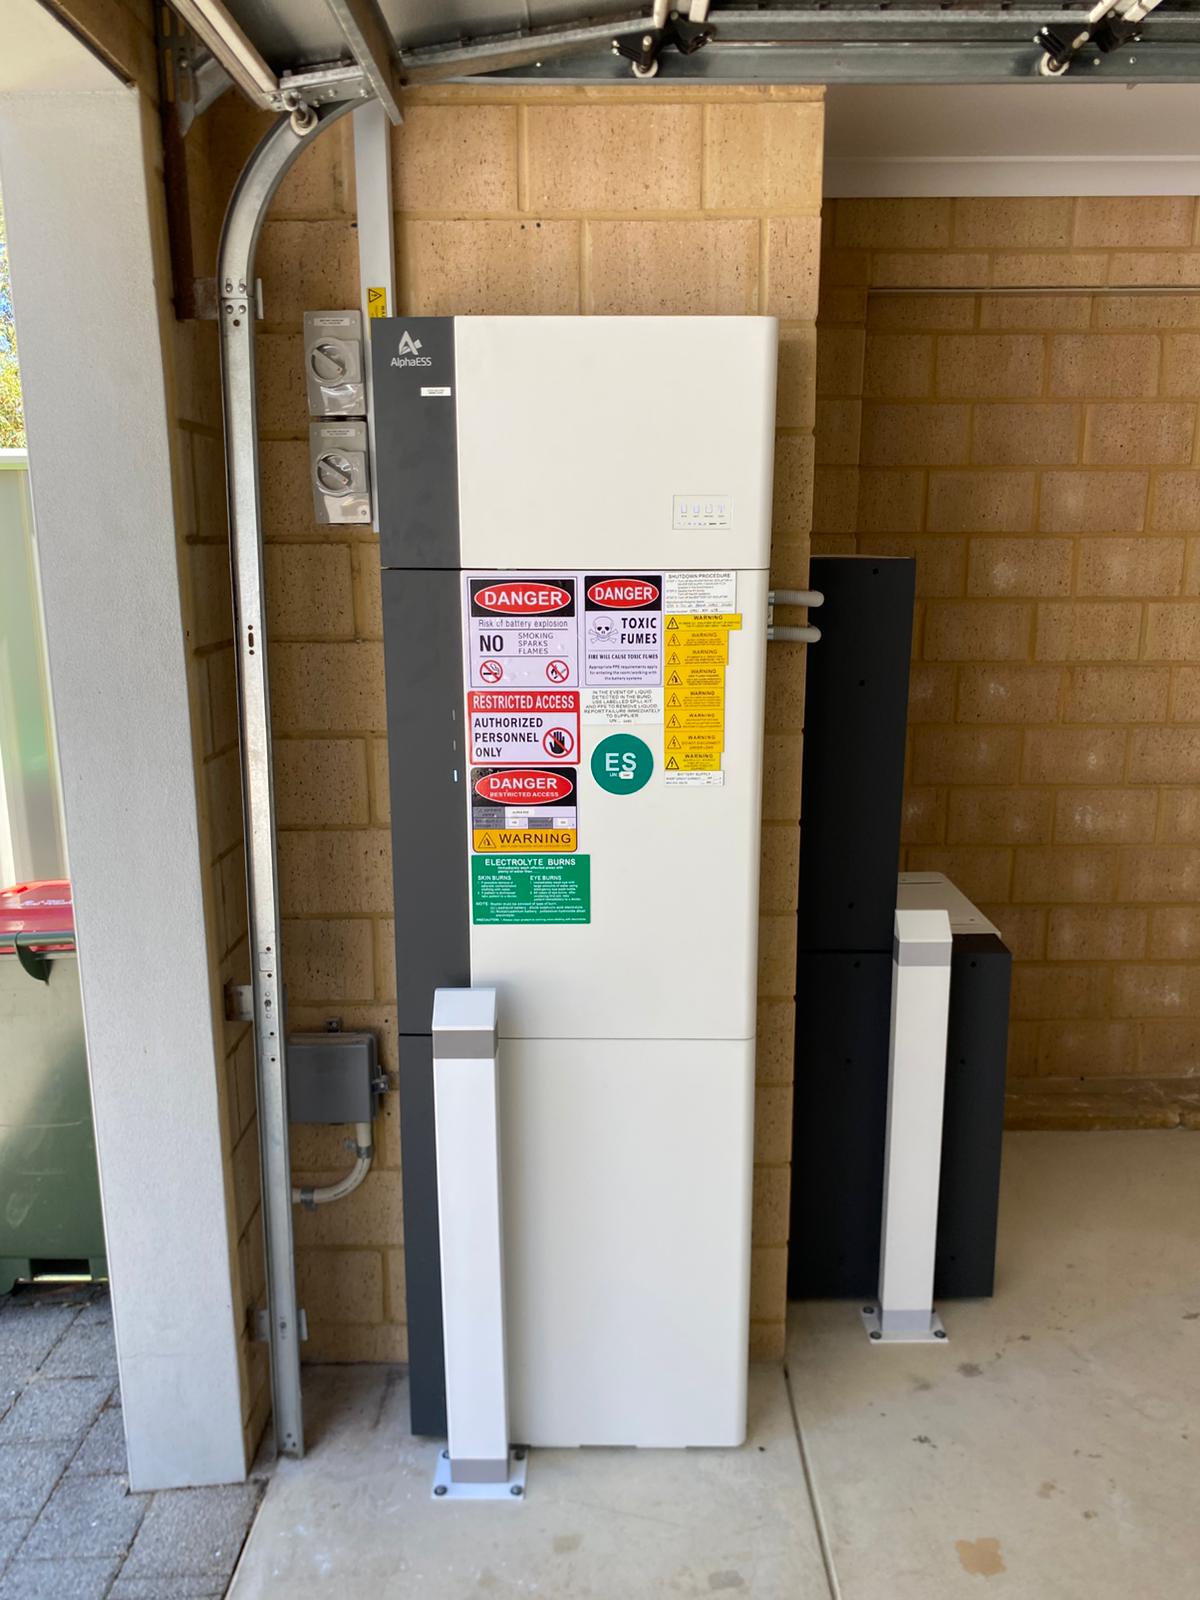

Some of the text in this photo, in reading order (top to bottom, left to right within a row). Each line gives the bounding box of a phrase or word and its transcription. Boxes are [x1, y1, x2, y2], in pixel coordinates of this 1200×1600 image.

[390, 357, 432, 368] AlphaESS
[484, 591, 563, 606] DANGER
[595, 587, 653, 601] DANGER
[479, 620, 568, 628] Risk of battery explosion
[621, 618, 657, 629] TOXIC
[518, 632, 554, 640] SMOKING
[620, 633, 657, 644] FUMES
[480, 635, 504, 652] NO
[473, 695, 574, 709] RESTRICTED ACCESS
[474, 718, 544, 728] AUTHORIZED
[475, 732, 539, 742] PERSONNEL
[475, 747, 502, 757] ONLY
[605, 752, 637, 771] ES
[489, 778, 558, 789] DANGER
[499, 834, 571, 844] WARNING
